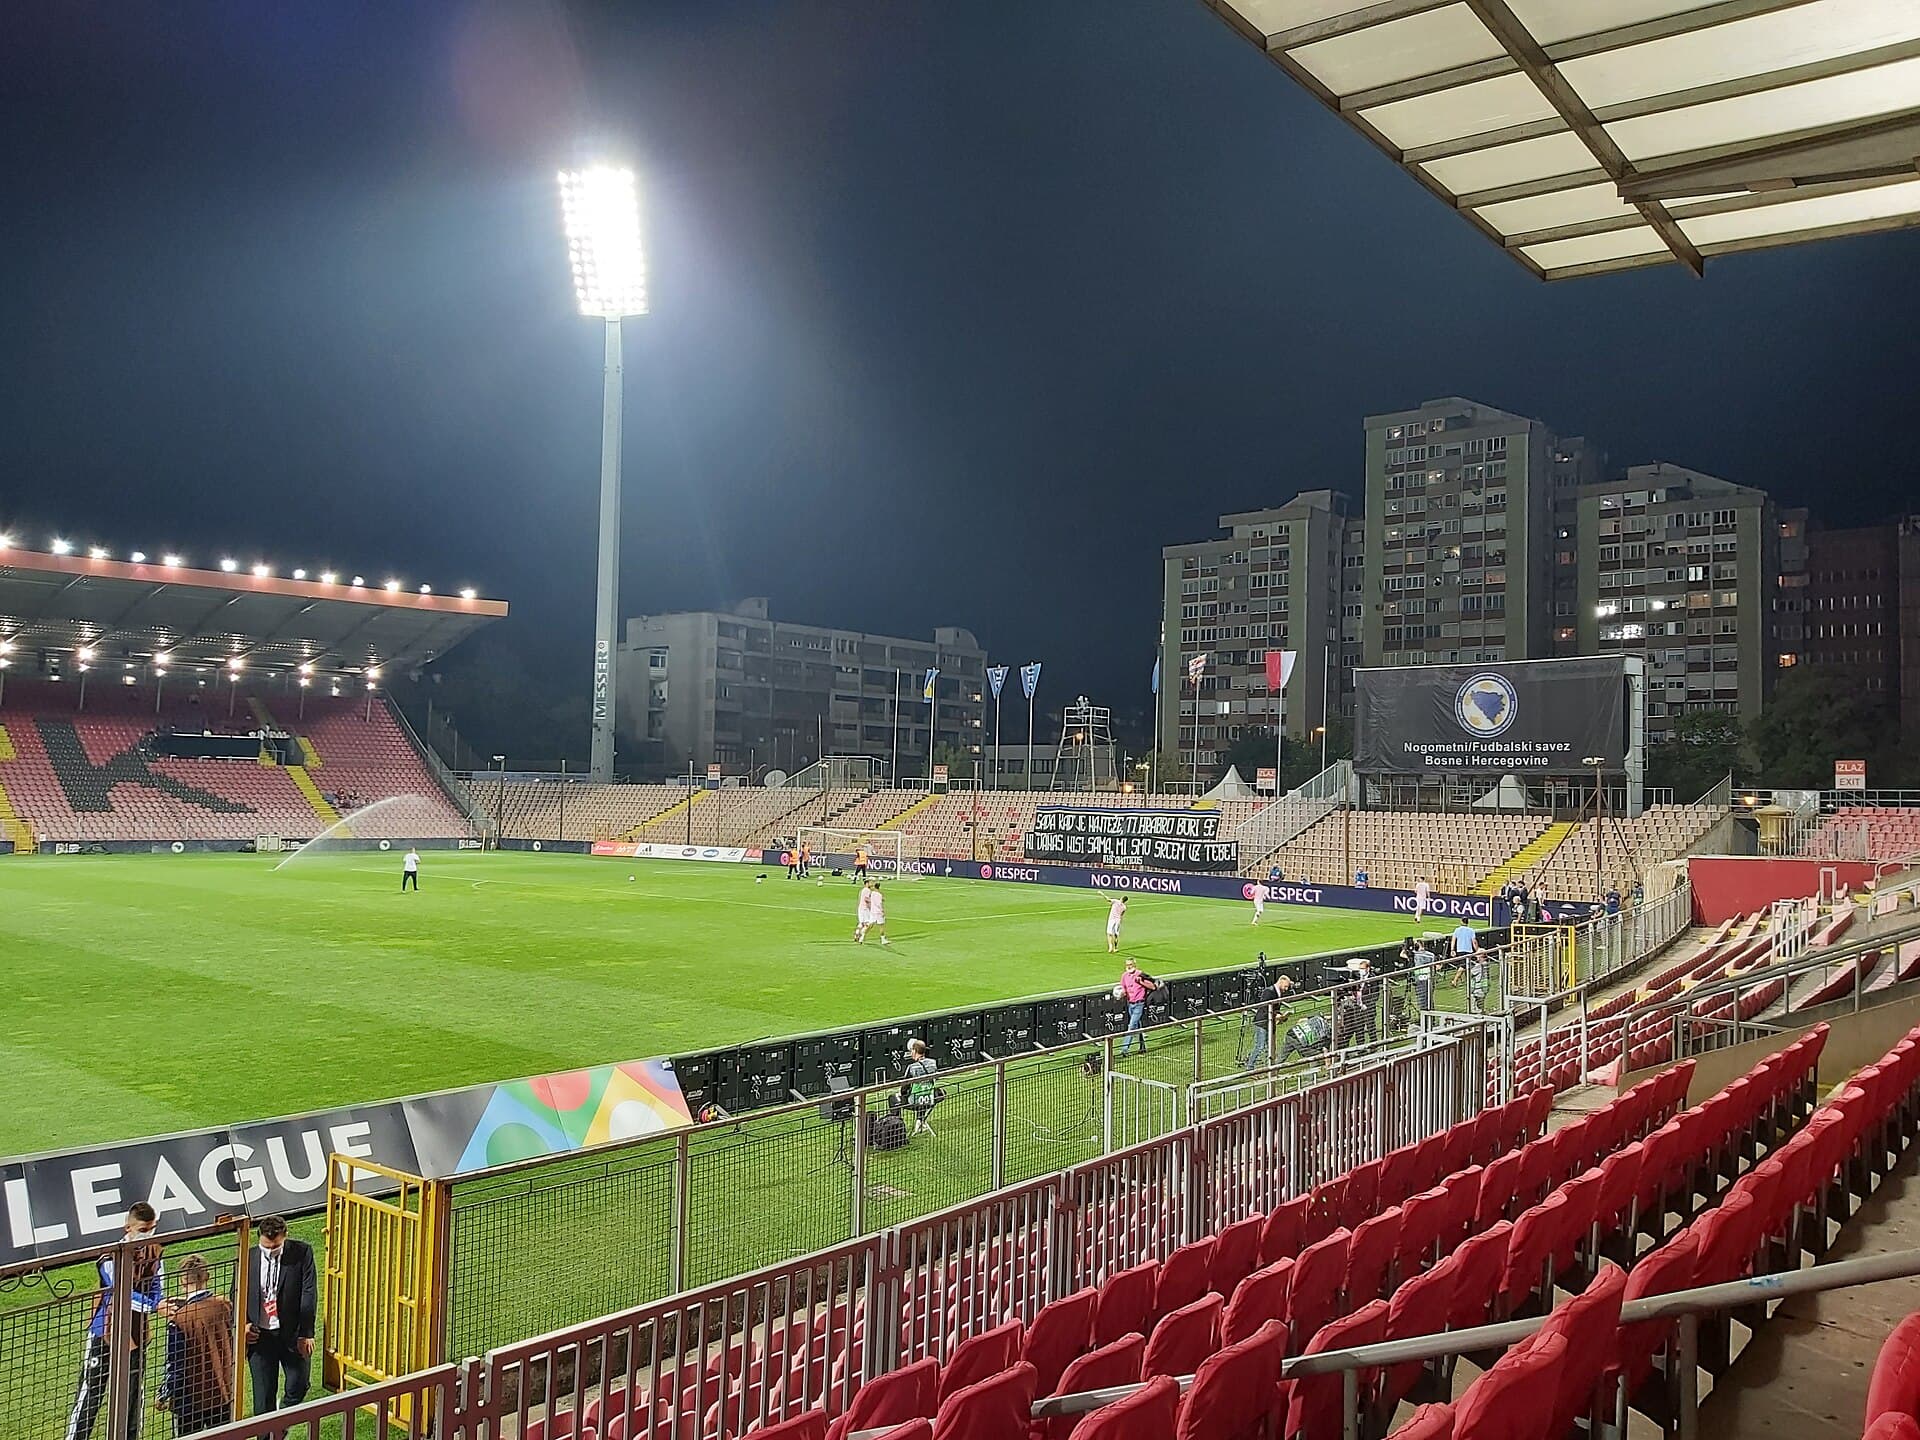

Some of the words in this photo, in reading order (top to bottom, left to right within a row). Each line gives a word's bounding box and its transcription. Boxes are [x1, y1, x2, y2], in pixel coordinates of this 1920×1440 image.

[595, 651, 608, 718] MESSER
[1403, 741, 1532, 754] Nogometni/Fudbalski
[1535, 743, 1571, 752] savez
[1425, 755, 1462, 766] Bosne
[1465, 755, 1469, 766] i
[1471, 755, 1549, 768] Hercegovine
[1840, 778, 1860, 786] EXIT
[1035, 813, 1056, 831] SADA
[1075, 815, 1087, 832] JE
[1126, 816, 1139, 834] TI
[1137, 816, 1175, 835] HRABRO
[1176, 818, 1201, 837] BORI
[1203, 818, 1218, 837] SE
[1037, 833, 1064, 851] DANAS
[1066, 836, 1085, 853] NISI
[1115, 838, 1128, 856] MI
[1130, 838, 1152, 856] SMO
[1153, 841, 1186, 861] SRCEM
[1188, 843, 1202, 862] UZ
[867, 859, 881, 871] NO
[883, 861, 896, 872] TO
[898, 861, 936, 875] RACISM
[995, 867, 1040, 882] RESPECT
[1091, 873, 1110, 887] NO
[1112, 875, 1130, 889] TO
[1132, 876, 1182, 893] RACISM
[1262, 886, 1323, 903] RESPECT
[1393, 895, 1419, 911] NO
[1425, 898, 1447, 914] TO
[4, 1121, 383, 1248] LEAGUE
